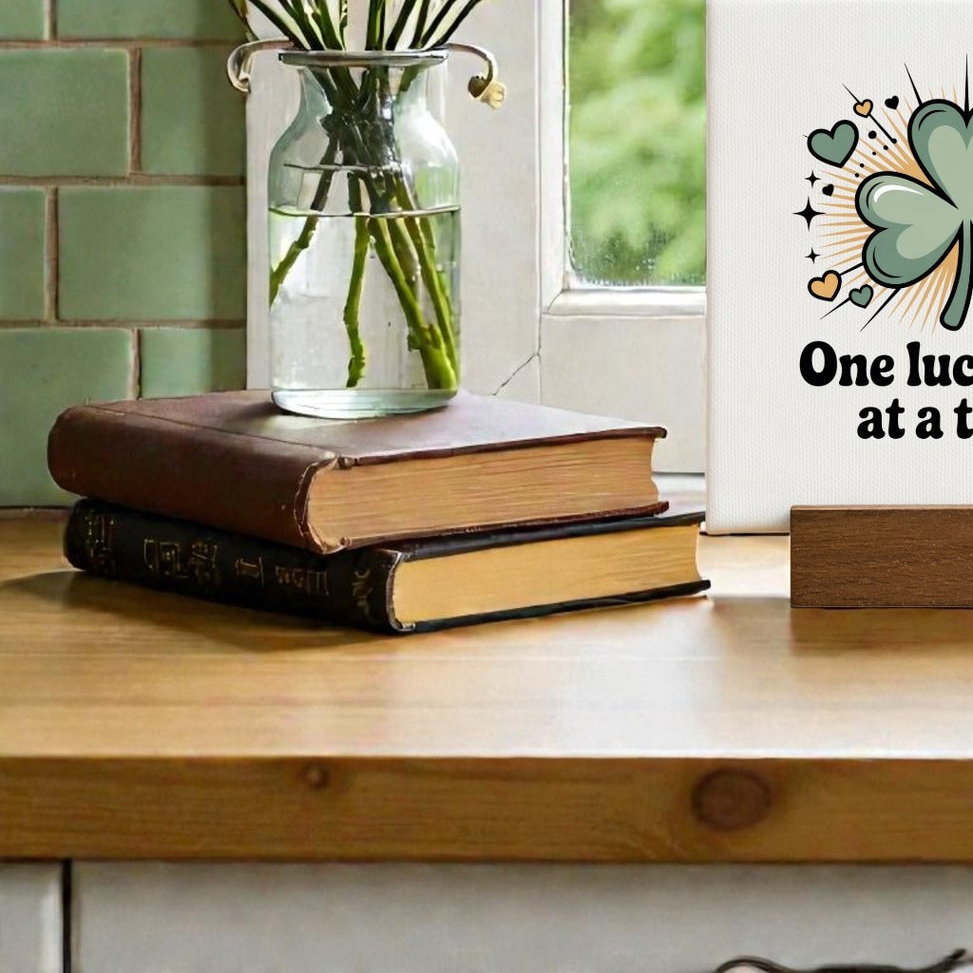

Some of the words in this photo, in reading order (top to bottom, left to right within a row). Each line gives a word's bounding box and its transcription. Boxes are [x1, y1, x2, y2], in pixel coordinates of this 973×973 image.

[799, 340, 895, 387] One
[856, 398, 906, 440] at
[915, 406, 944, 440] a
